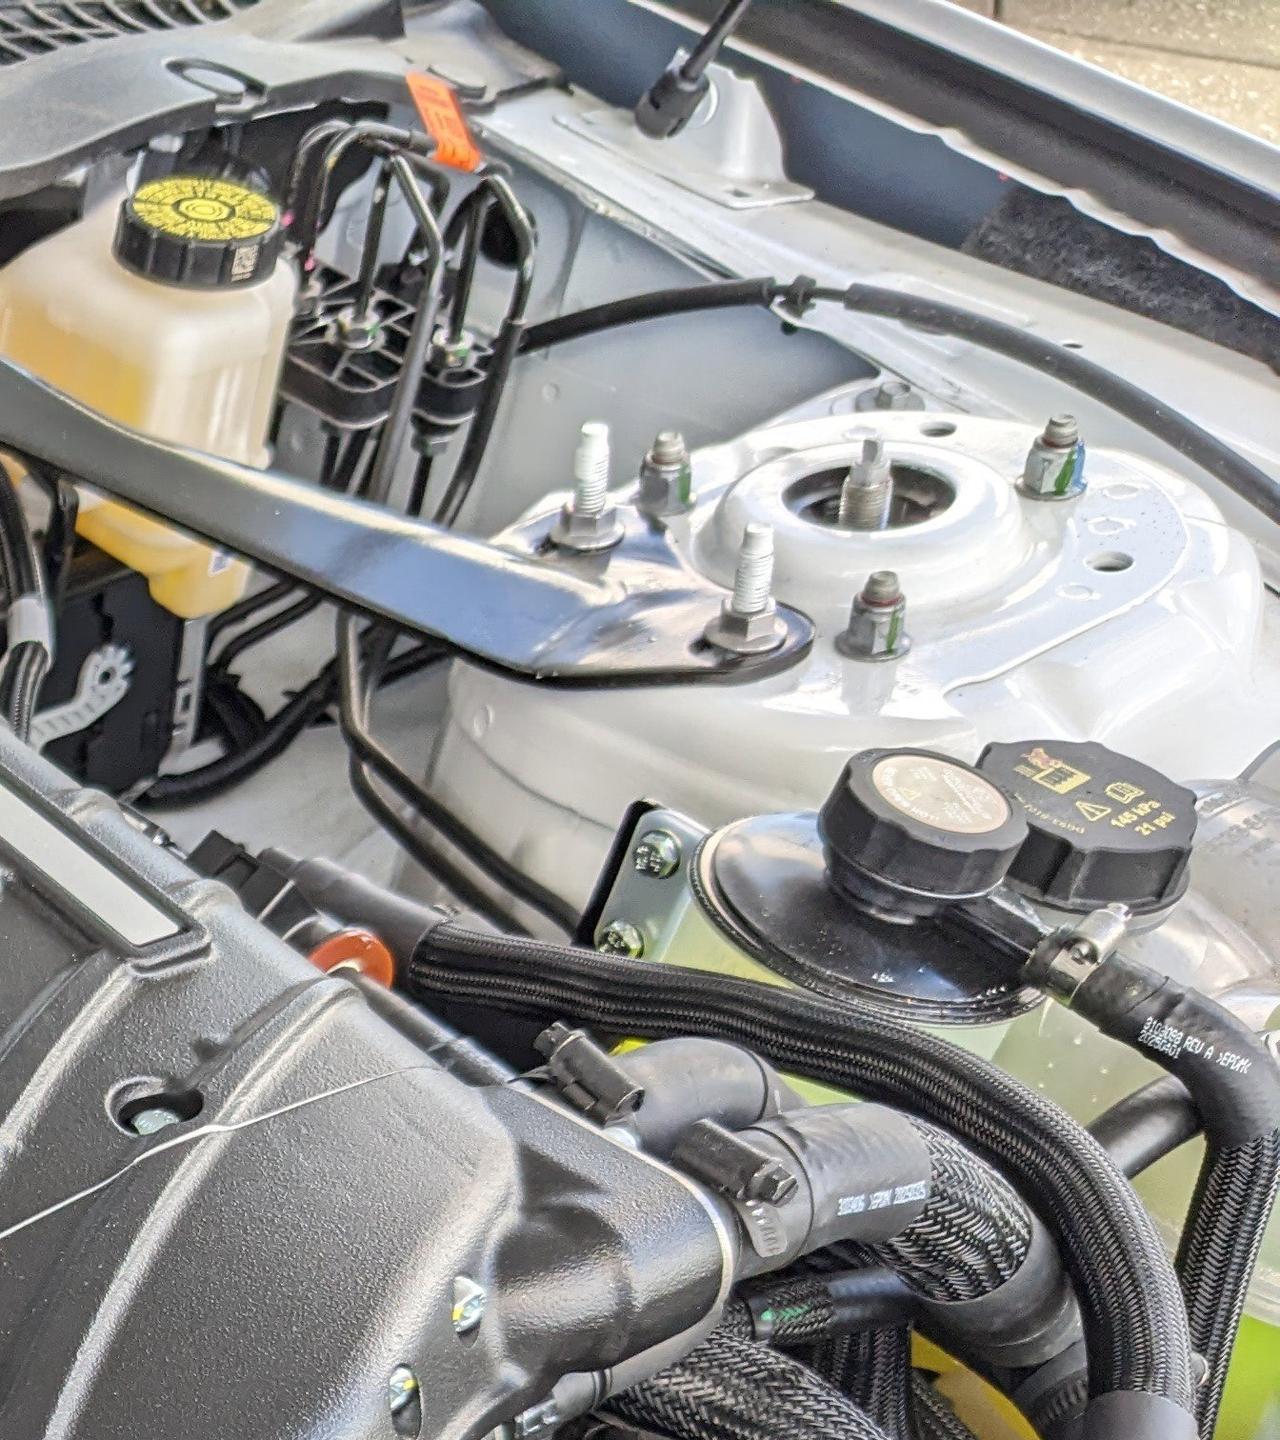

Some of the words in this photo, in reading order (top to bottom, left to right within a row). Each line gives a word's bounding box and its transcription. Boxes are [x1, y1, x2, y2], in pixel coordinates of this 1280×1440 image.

[1134, 822, 1157, 836] 21
[1152, 811, 1176, 828] psi
[1203, 1045, 1214, 1059] A
